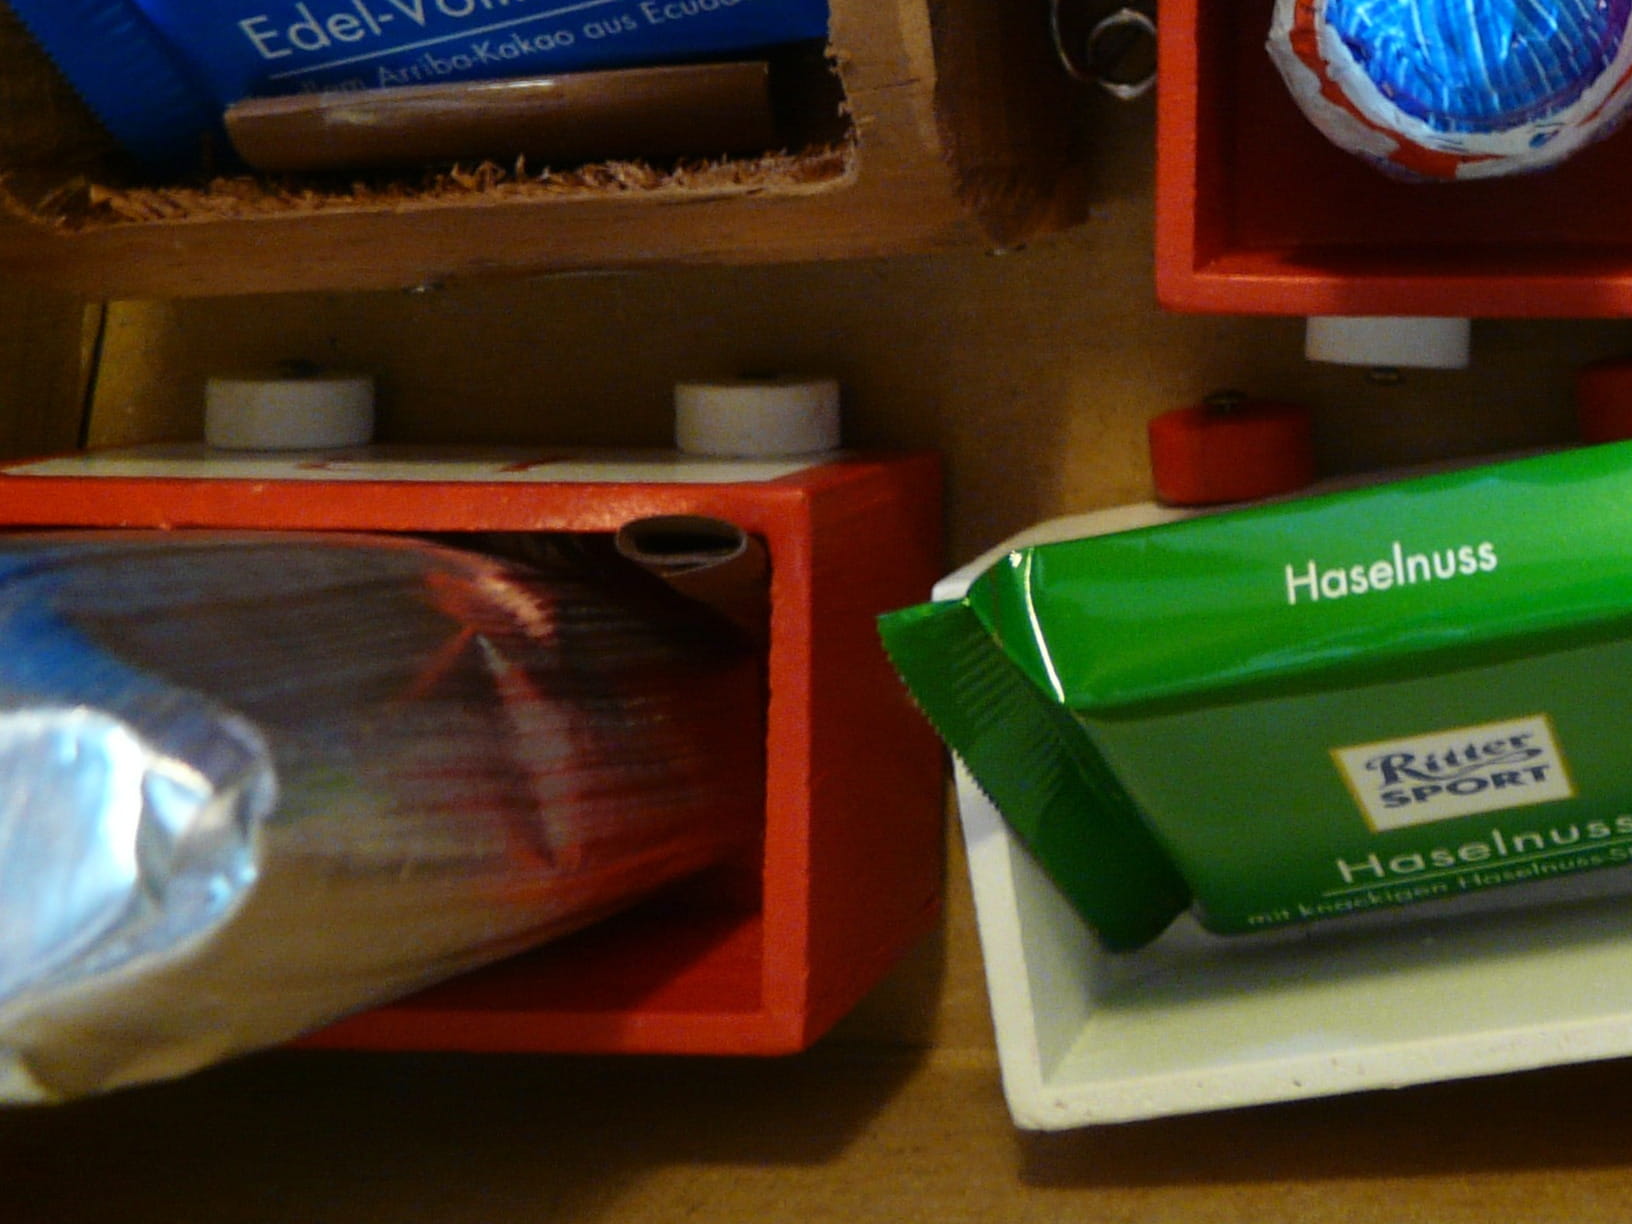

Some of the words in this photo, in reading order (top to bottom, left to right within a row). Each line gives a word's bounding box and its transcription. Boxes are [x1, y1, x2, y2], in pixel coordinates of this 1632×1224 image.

[583, 13, 637, 40] aus
[1285, 541, 1498, 605] Haselnuss
[1365, 732, 1543, 790] Ritter
[1380, 765, 1550, 809] SPORT
